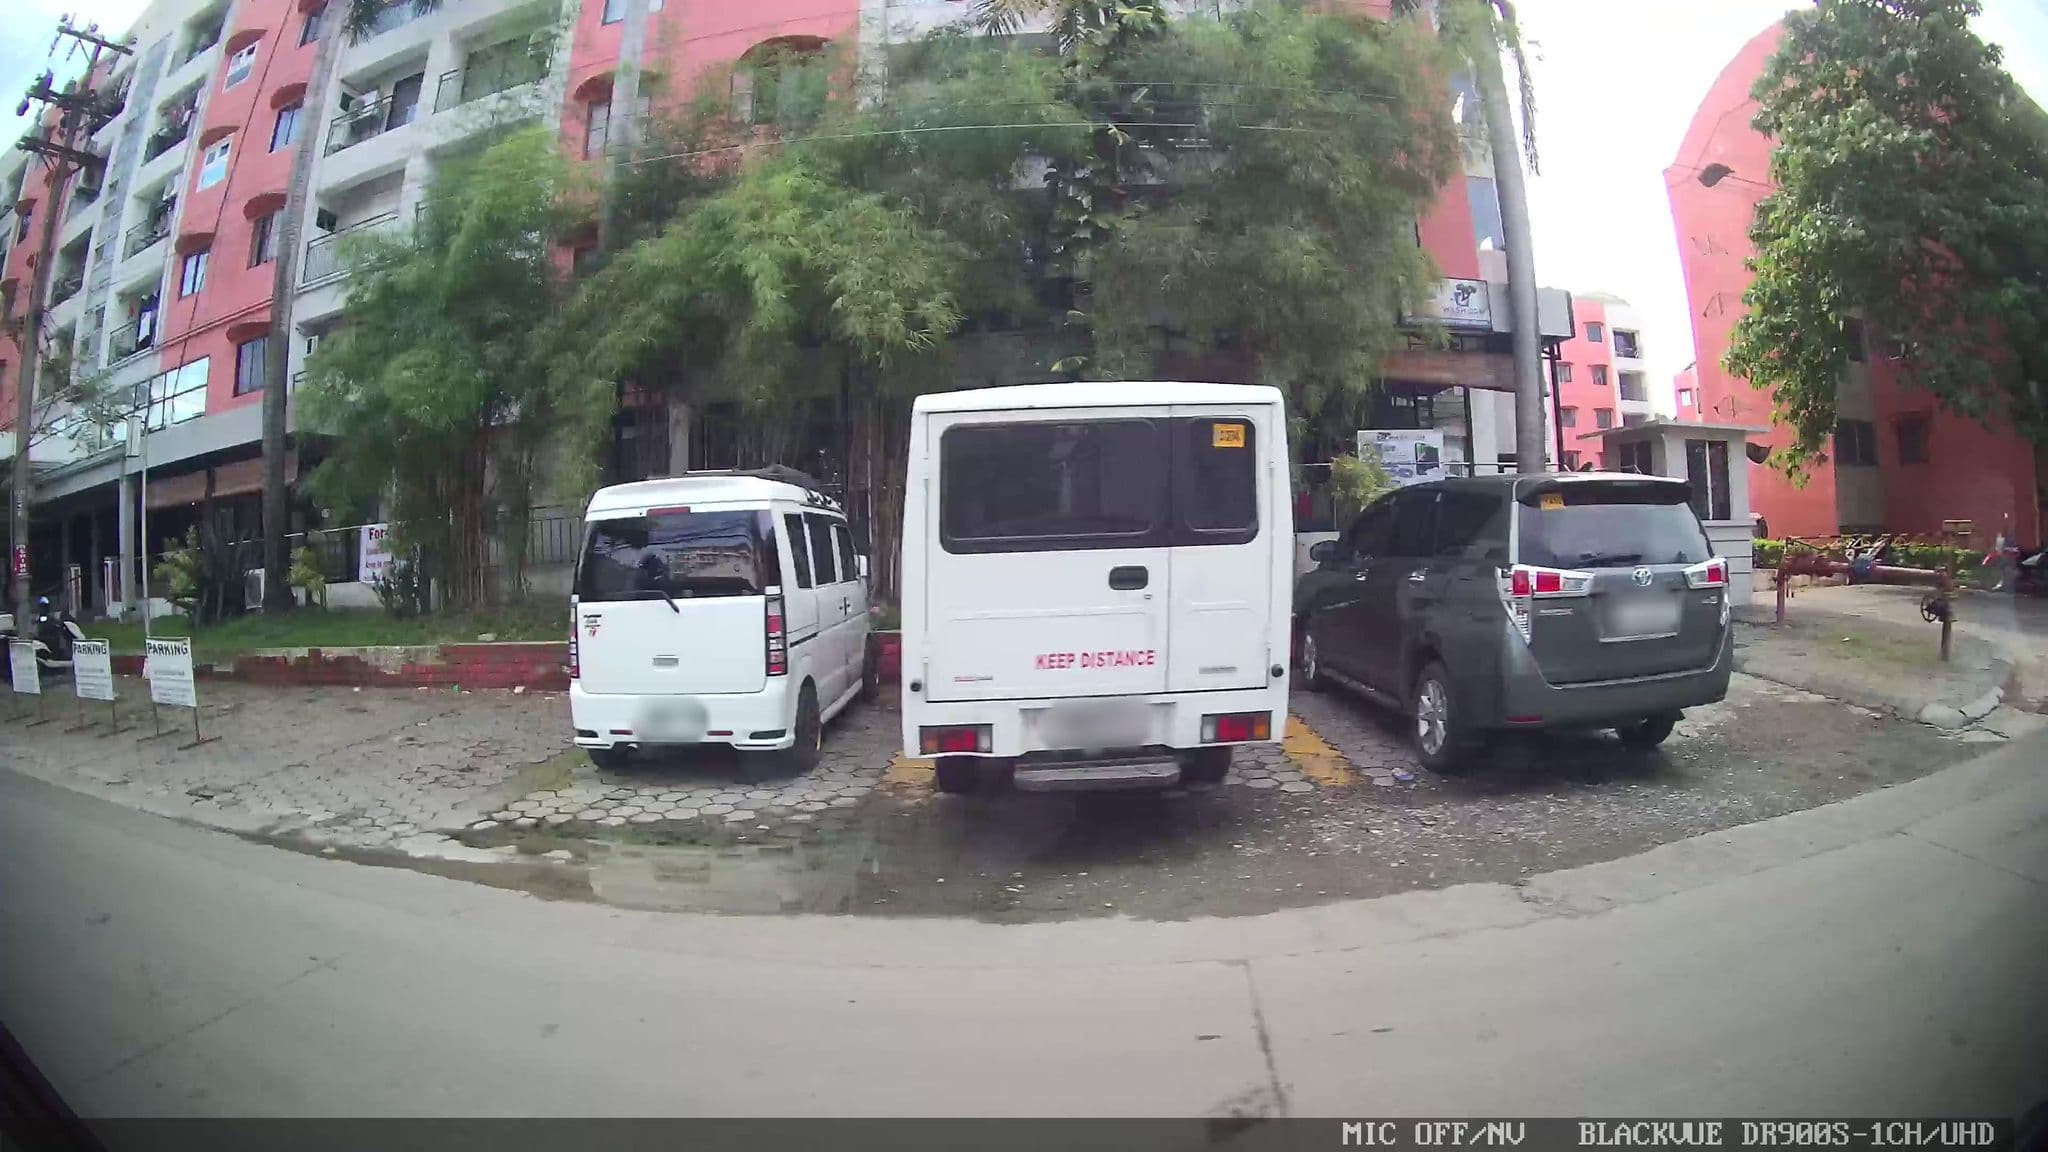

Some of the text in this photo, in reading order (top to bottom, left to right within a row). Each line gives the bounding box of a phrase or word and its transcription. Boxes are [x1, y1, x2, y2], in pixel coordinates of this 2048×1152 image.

[72, 643, 107, 656] PARKING
[147, 642, 188, 656] PARKING
[1036, 649, 1156, 669] KEEP DISTANCE
